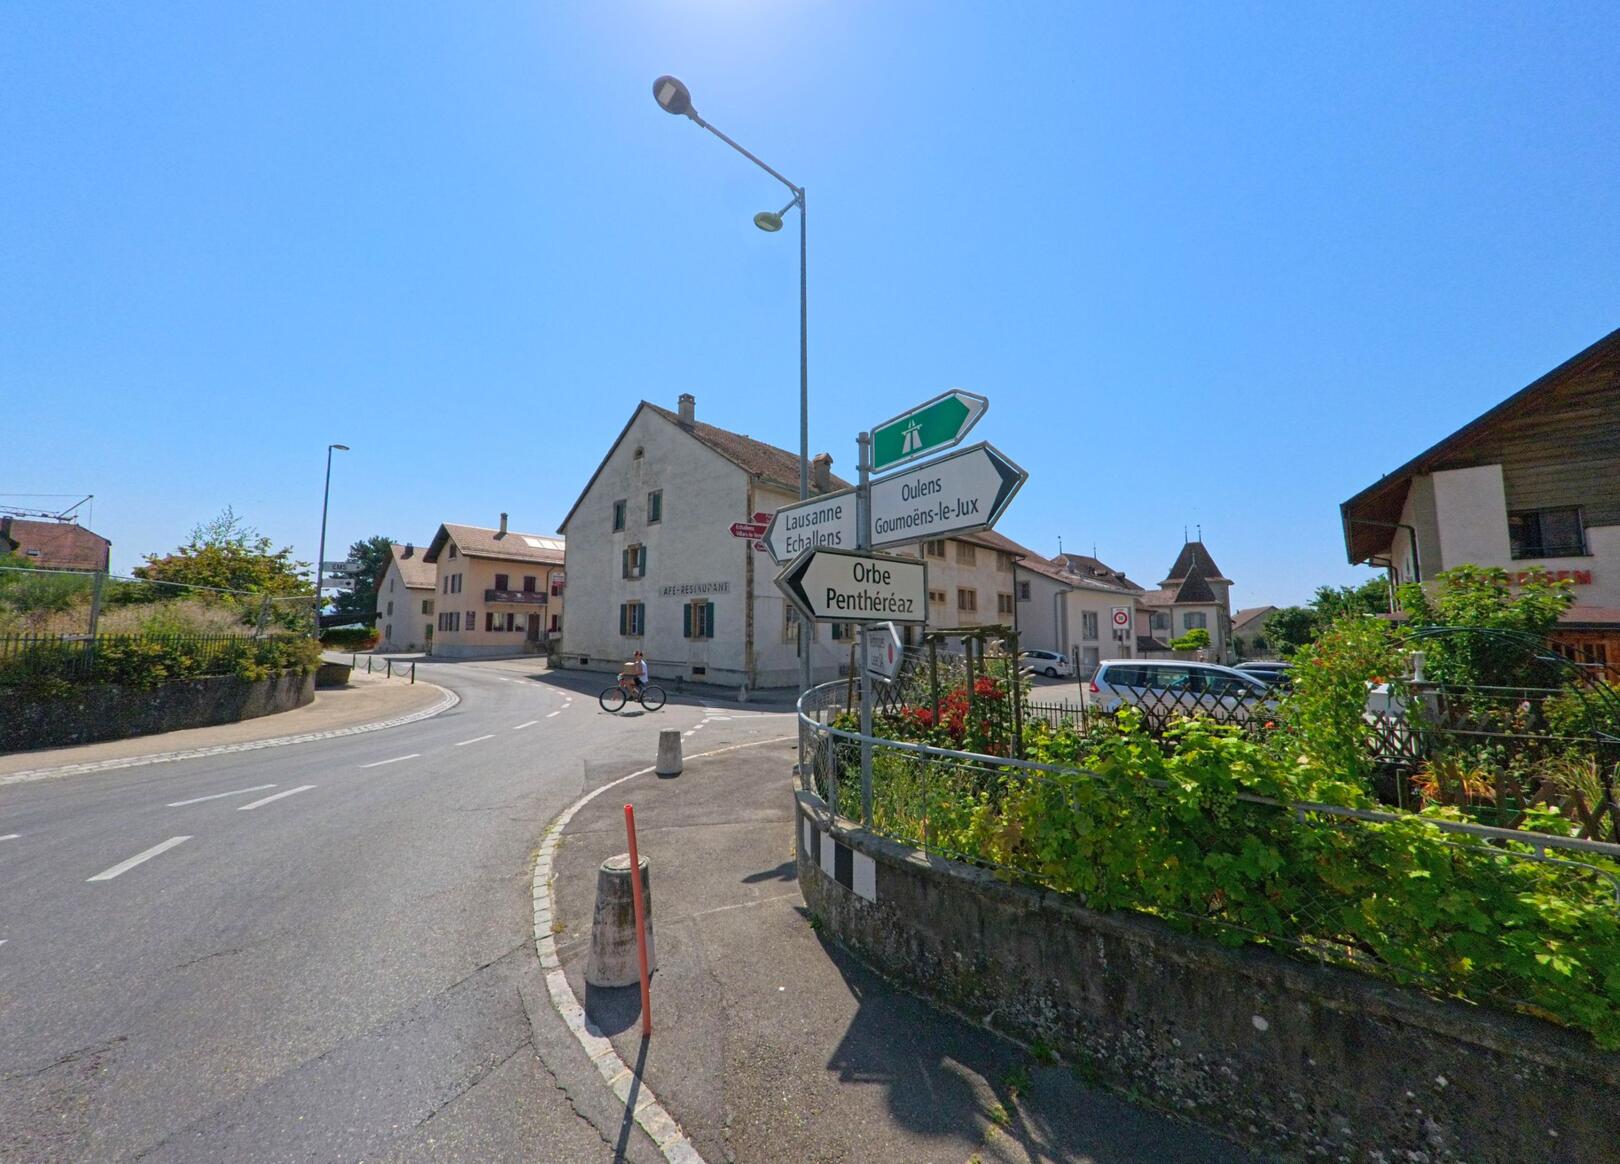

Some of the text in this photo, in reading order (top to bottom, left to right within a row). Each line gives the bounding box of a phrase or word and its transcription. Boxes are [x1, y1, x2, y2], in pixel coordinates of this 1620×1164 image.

[901, 478, 942, 502] Oulens
[786, 505, 842, 531] Lausanne
[875, 498, 979, 534] Goumoëns-le-Jux
[786, 530, 842, 554] Echallens
[853, 562, 891, 585] Orbe
[826, 587, 913, 614] Penthéréaz
